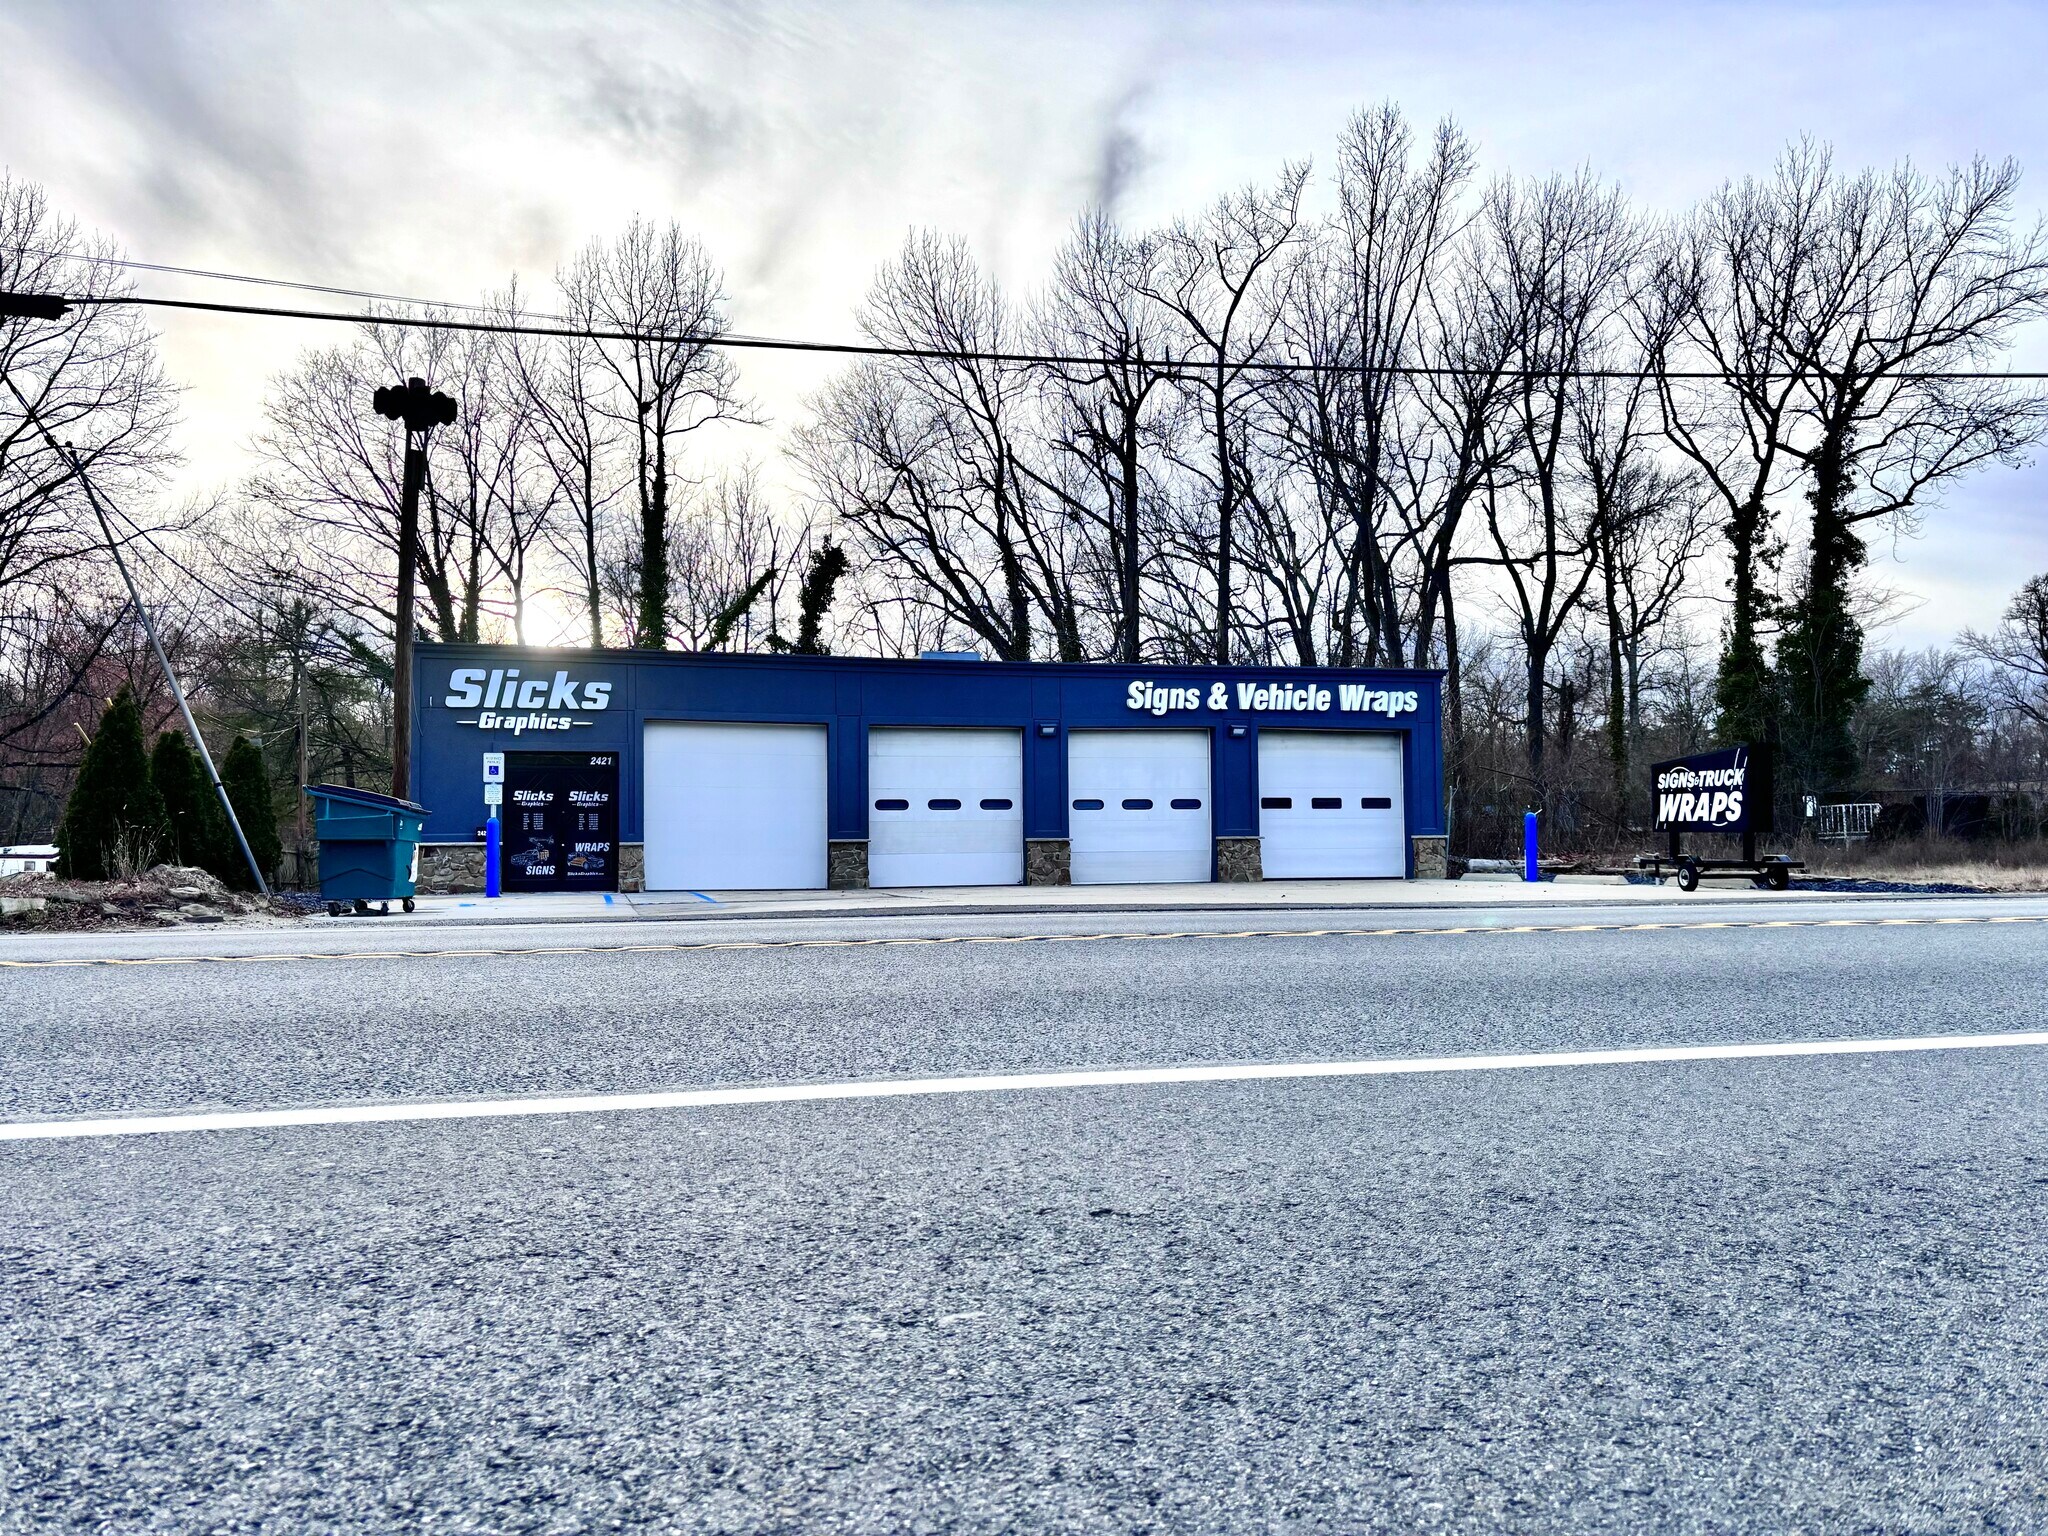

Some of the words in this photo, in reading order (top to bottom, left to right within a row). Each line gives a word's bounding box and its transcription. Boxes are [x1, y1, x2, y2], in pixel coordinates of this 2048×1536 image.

[445, 669, 612, 710] Slicks
[1126, 680, 1201, 716] Signs
[1206, 682, 1229, 710] &
[1236, 683, 1331, 712] Vehicle
[1338, 684, 1418, 718] Wraps
[478, 711, 572, 736] Graphics
[590, 756, 612, 765] 2421
[512, 790, 554, 801] Slicks
[568, 791, 609, 802] Slicks
[1659, 791, 1743, 822] WRAPS
[575, 842, 610, 852] WRAPS
[525, 865, 556, 876] SIGNS
